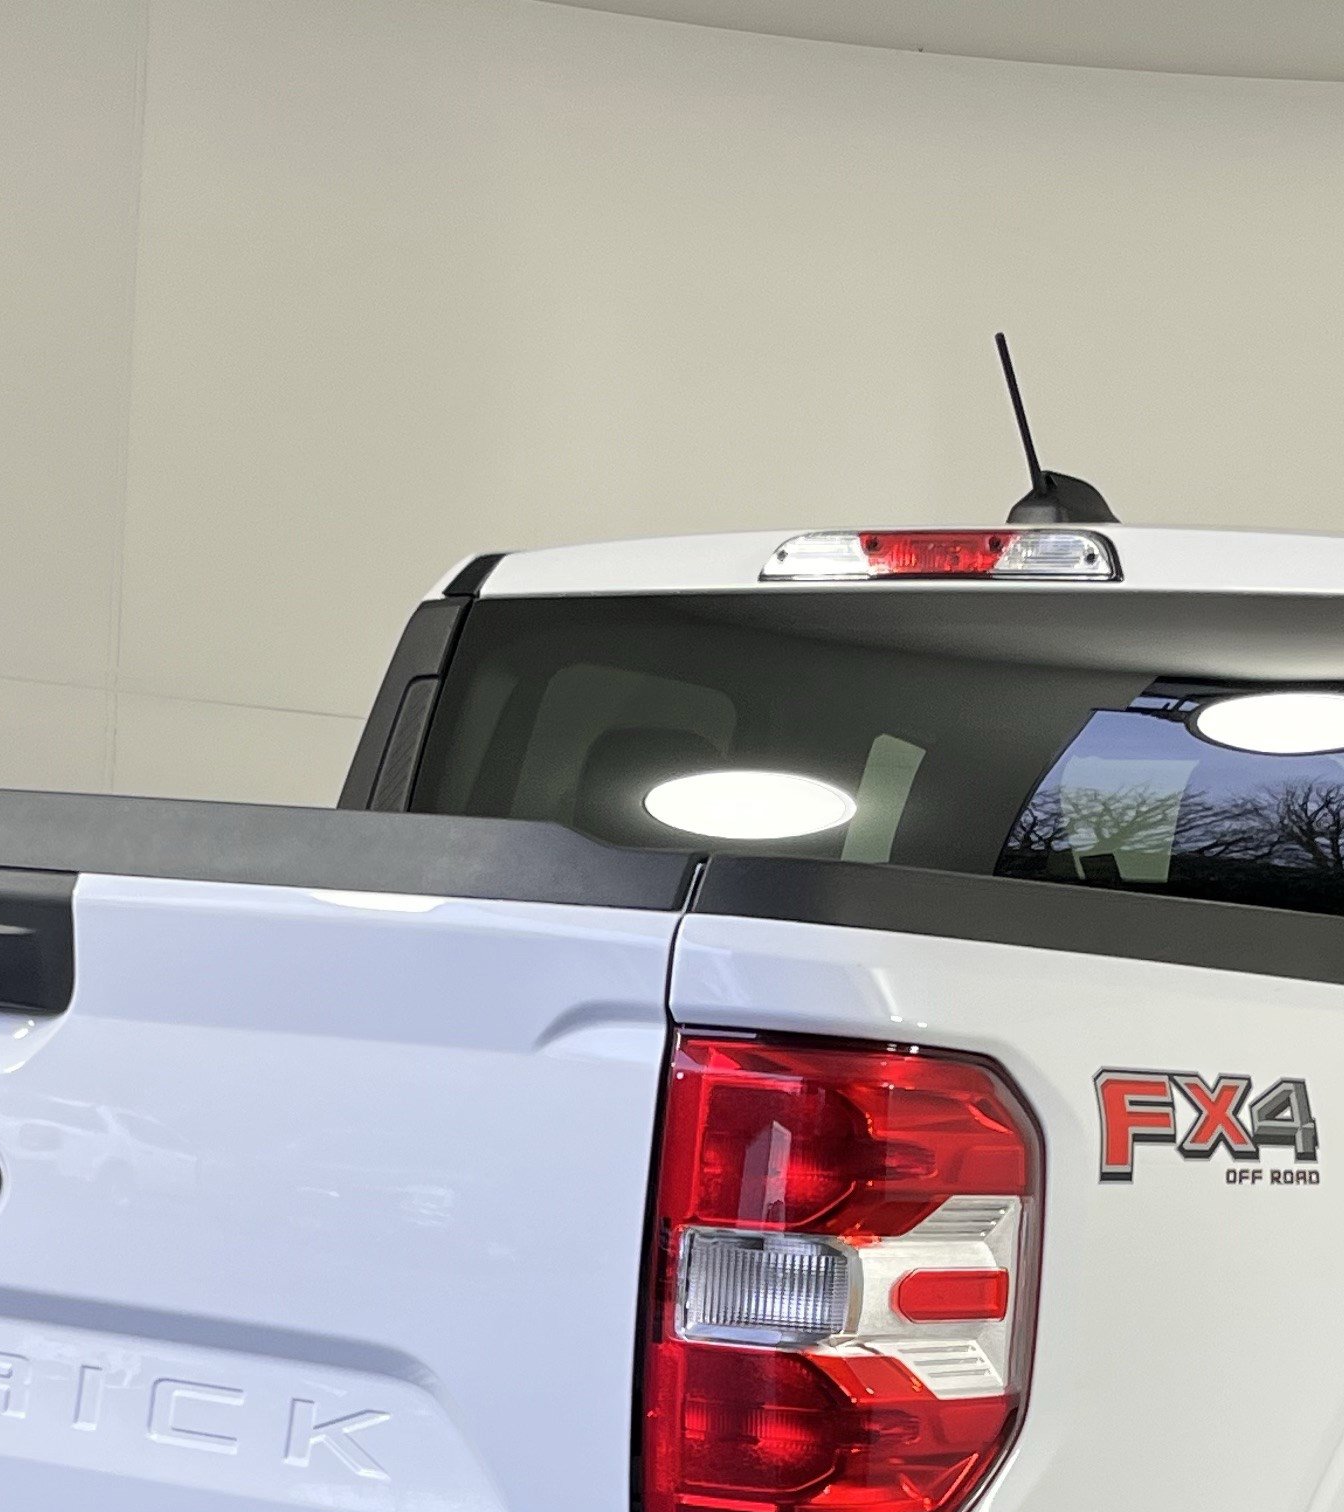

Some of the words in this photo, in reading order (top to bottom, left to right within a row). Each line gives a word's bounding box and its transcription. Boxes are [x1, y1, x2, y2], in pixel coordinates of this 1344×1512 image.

[1093, 1065, 1319, 1184] FX4
[1225, 1168, 1263, 1186] OFF
[1270, 1168, 1321, 1186] ROAD
